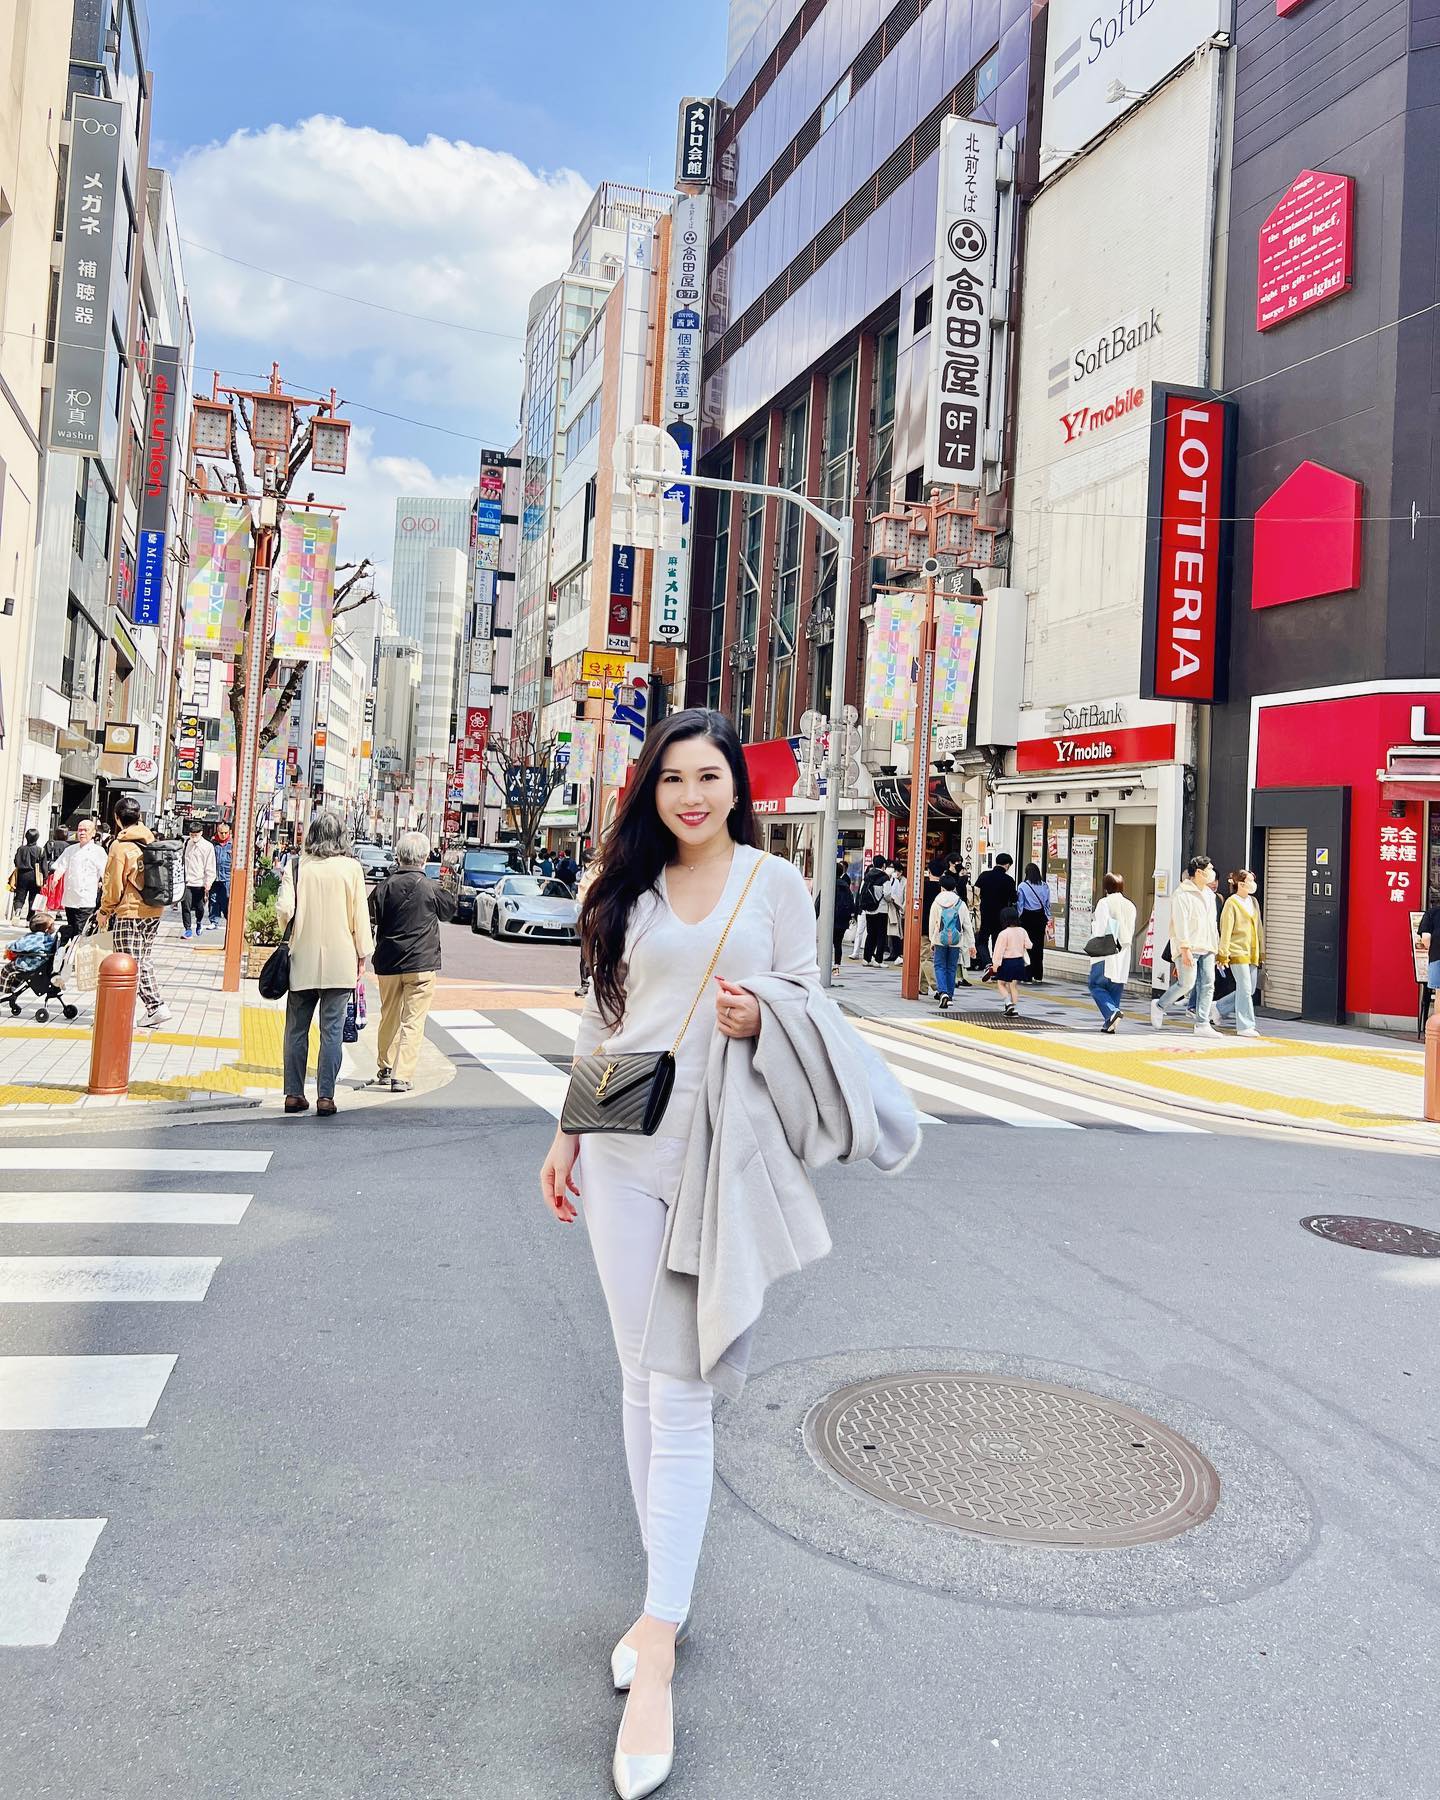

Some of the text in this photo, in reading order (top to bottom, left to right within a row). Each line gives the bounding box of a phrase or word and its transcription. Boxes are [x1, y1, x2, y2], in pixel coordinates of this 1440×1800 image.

[688, 108, 705, 175] メトロ会館
[963, 132, 980, 213] 北前そば
[80, 172, 103, 236] メガネ
[1289, 234, 1306, 249] the
[74, 258, 98, 326] 補聴器
[1288, 296, 1297, 308] is
[1303, 271, 1340, 301] might!
[1073, 308, 1162, 382] SoftBank
[674, 333, 692, 399] 個室会議室
[65, 388, 92, 426] 和真
[945, 410, 973, 431] 6F
[1059, 387, 1145, 444] Y!mobile
[57, 430, 94, 442] washin
[147, 374, 169, 497] disk union
[944, 442, 971, 464] 7F
[1171, 408, 1209, 681] LOTTERIA
[142, 546, 157, 619] Mitsumine
[664, 556, 679, 621] 麻雀メトロ
[1063, 702, 1123, 731] SoftBank
[1053, 740, 1113, 763] Y!mobile
[1380, 826, 1417, 844] 完全
[1380, 845, 1417, 863] 禁煙
[1385, 871, 1410, 888] 75
[1390, 888, 1405, 903] 席
